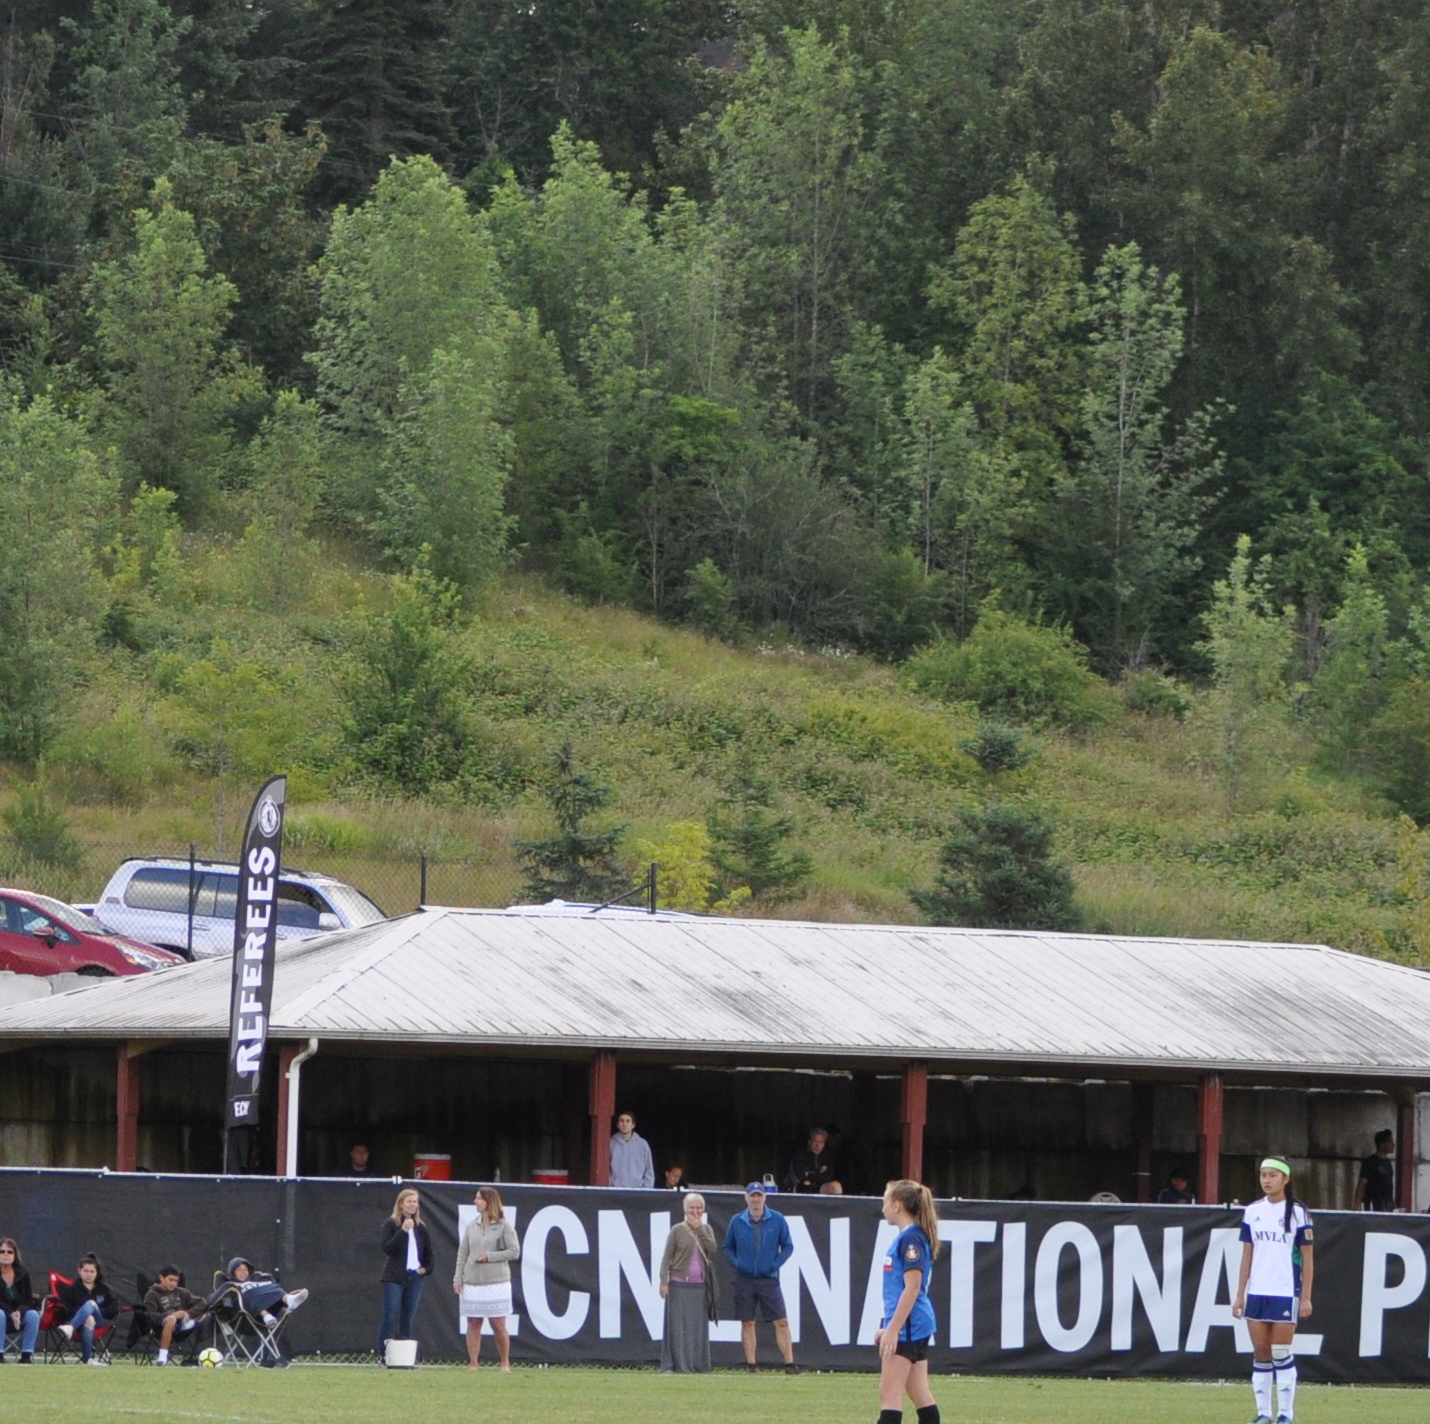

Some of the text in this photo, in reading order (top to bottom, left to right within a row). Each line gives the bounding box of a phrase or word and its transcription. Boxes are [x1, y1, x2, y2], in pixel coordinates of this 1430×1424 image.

[236, 846, 276, 1074] REFEREES
[458, 1204, 742, 1341] CN
[1254, 1230, 1287, 1244] MVLA
